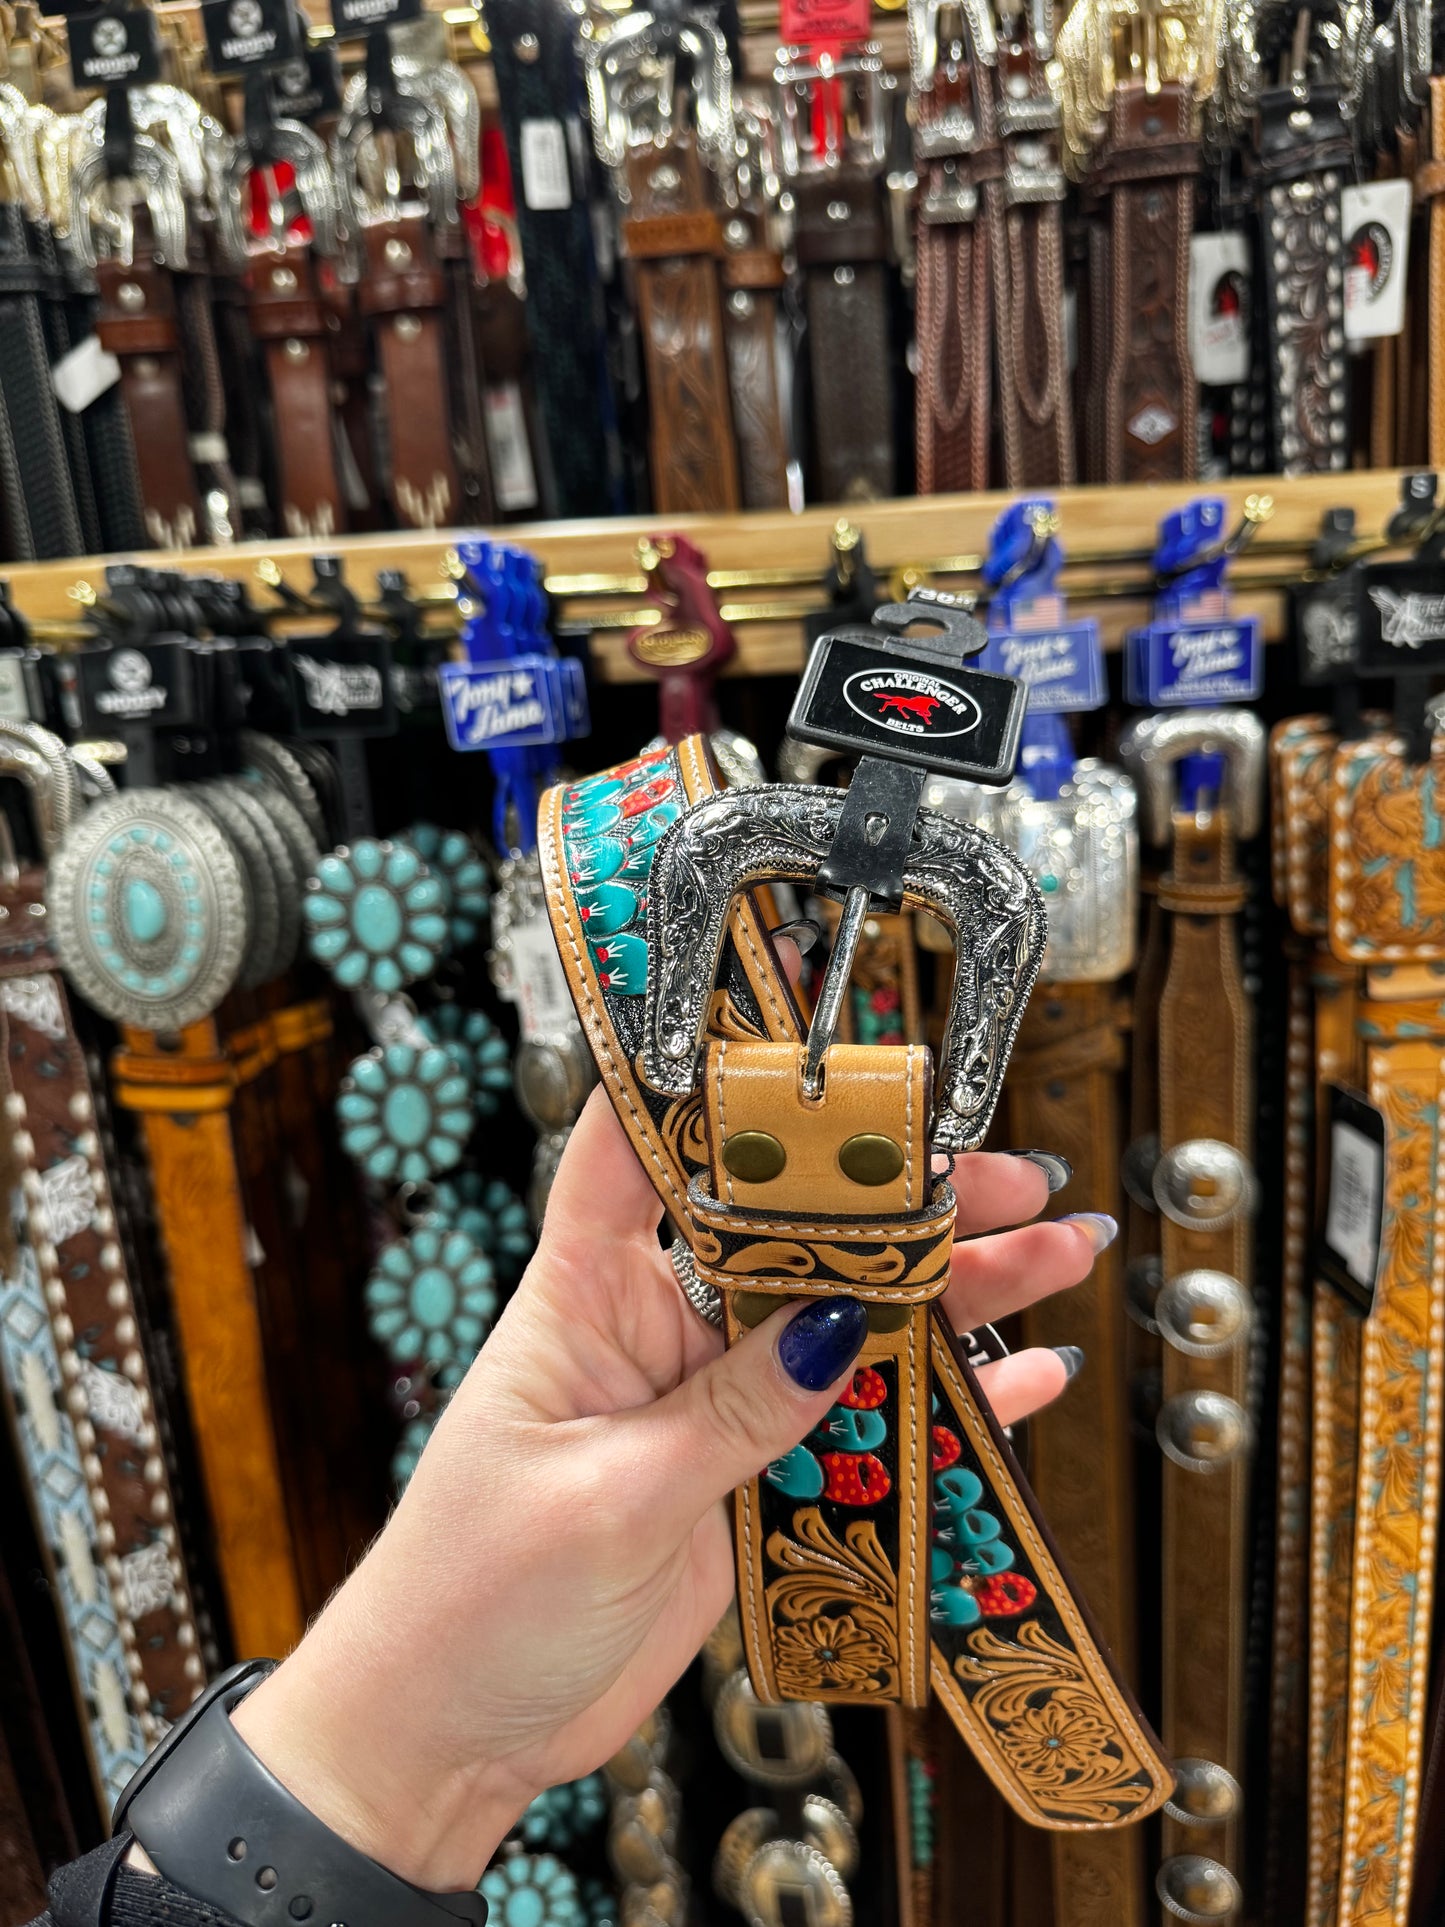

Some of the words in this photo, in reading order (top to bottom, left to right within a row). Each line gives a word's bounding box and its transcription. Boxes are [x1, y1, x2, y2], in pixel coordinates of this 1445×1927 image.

[221, 30, 277, 59] HOOEY
[83, 52, 141, 77] HOOEY
[894, 672, 941, 689] ORIGINAL
[447, 671, 512, 723] Tony
[860, 677, 968, 715] CHALLENGER
[465, 701, 546, 744] Lama
[885, 717, 925, 733] BELTS
